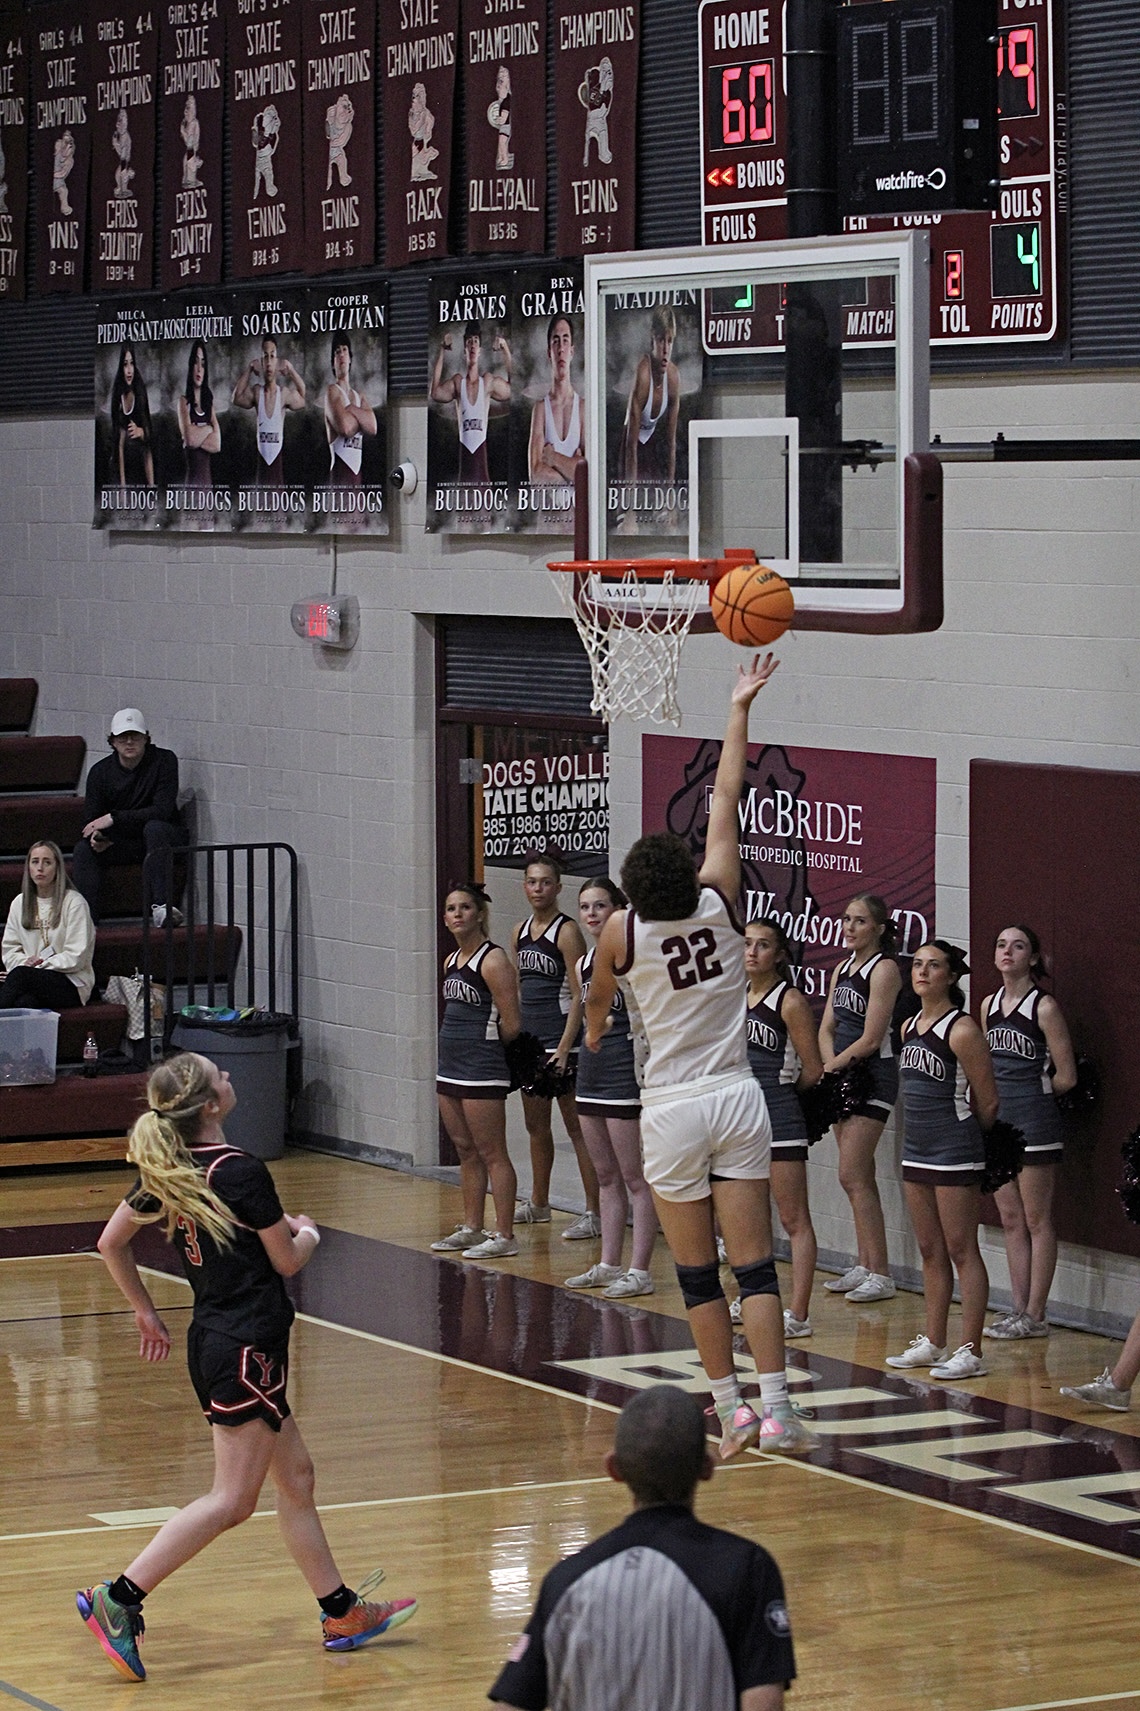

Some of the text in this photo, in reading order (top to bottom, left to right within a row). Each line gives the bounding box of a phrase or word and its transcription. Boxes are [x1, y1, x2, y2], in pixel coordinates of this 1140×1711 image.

[320, 8, 356, 45] STATE
[400, 0, 439, 30] STATE
[560, 6, 634, 51] CHAMPIONS
[714, 9, 769, 50] HOME
[175, 25, 209, 59] STATE
[246, 20, 281, 56] STATE
[469, 21, 539, 64] CHAMPIONS
[108, 41, 141, 75] STATE
[387, 31, 454, 78] CHAMPIONS
[47, 57, 76, 89] STATE
[164, 58, 221, 96] CHAMPIONS
[235, 59, 296, 100] CHAMPIONS
[308, 49, 371, 92] CHAMPIONS
[97, 74, 152, 112] CHAMPIONS
[722, 63, 772, 144] 60
[37, 96, 87, 129] CHAMPIONS
[738, 159, 785, 188] BONUS
[876, 171, 925, 191] watchfire
[713, 213, 757, 242] FOULS
[1017, 227, 1039, 290] 4
[460, 284, 488, 296] JOSH
[551, 277, 574, 289] BEN
[117, 310, 146, 321] MILCA
[260, 300, 283, 312] ERIC
[327, 294, 369, 308] COOPER
[439, 295, 507, 323] BARNES
[521, 289, 585, 317] GRAHA
[242, 311, 301, 337] SOARES
[311, 305, 385, 333] SULLIVAN
[708, 318, 752, 343] POINTS
[847, 310, 894, 336] MATCH
[940, 305, 970, 333] TOL
[991, 303, 1043, 329] POINTS
[165, 490, 231, 510] BULLDOGS
[238, 491, 306, 511] BULLDOGS
[312, 491, 382, 512] BULLDOGS
[517, 488, 575, 511] BULLD
[608, 487, 689, 510] BULLDOG
[483, 752, 609, 789] DOGS VOLLE
[483, 781, 609, 816] TATE CHAMPI
[483, 817, 507, 837] 985
[511, 815, 541, 834] 1986
[545, 812, 575, 833] 1987
[483, 838, 510, 857] 007
[585, 831, 609, 850] 201
[738, 844, 863, 873] RTHOPEDIC HOSPITAL
[661, 928, 723, 990] 22
